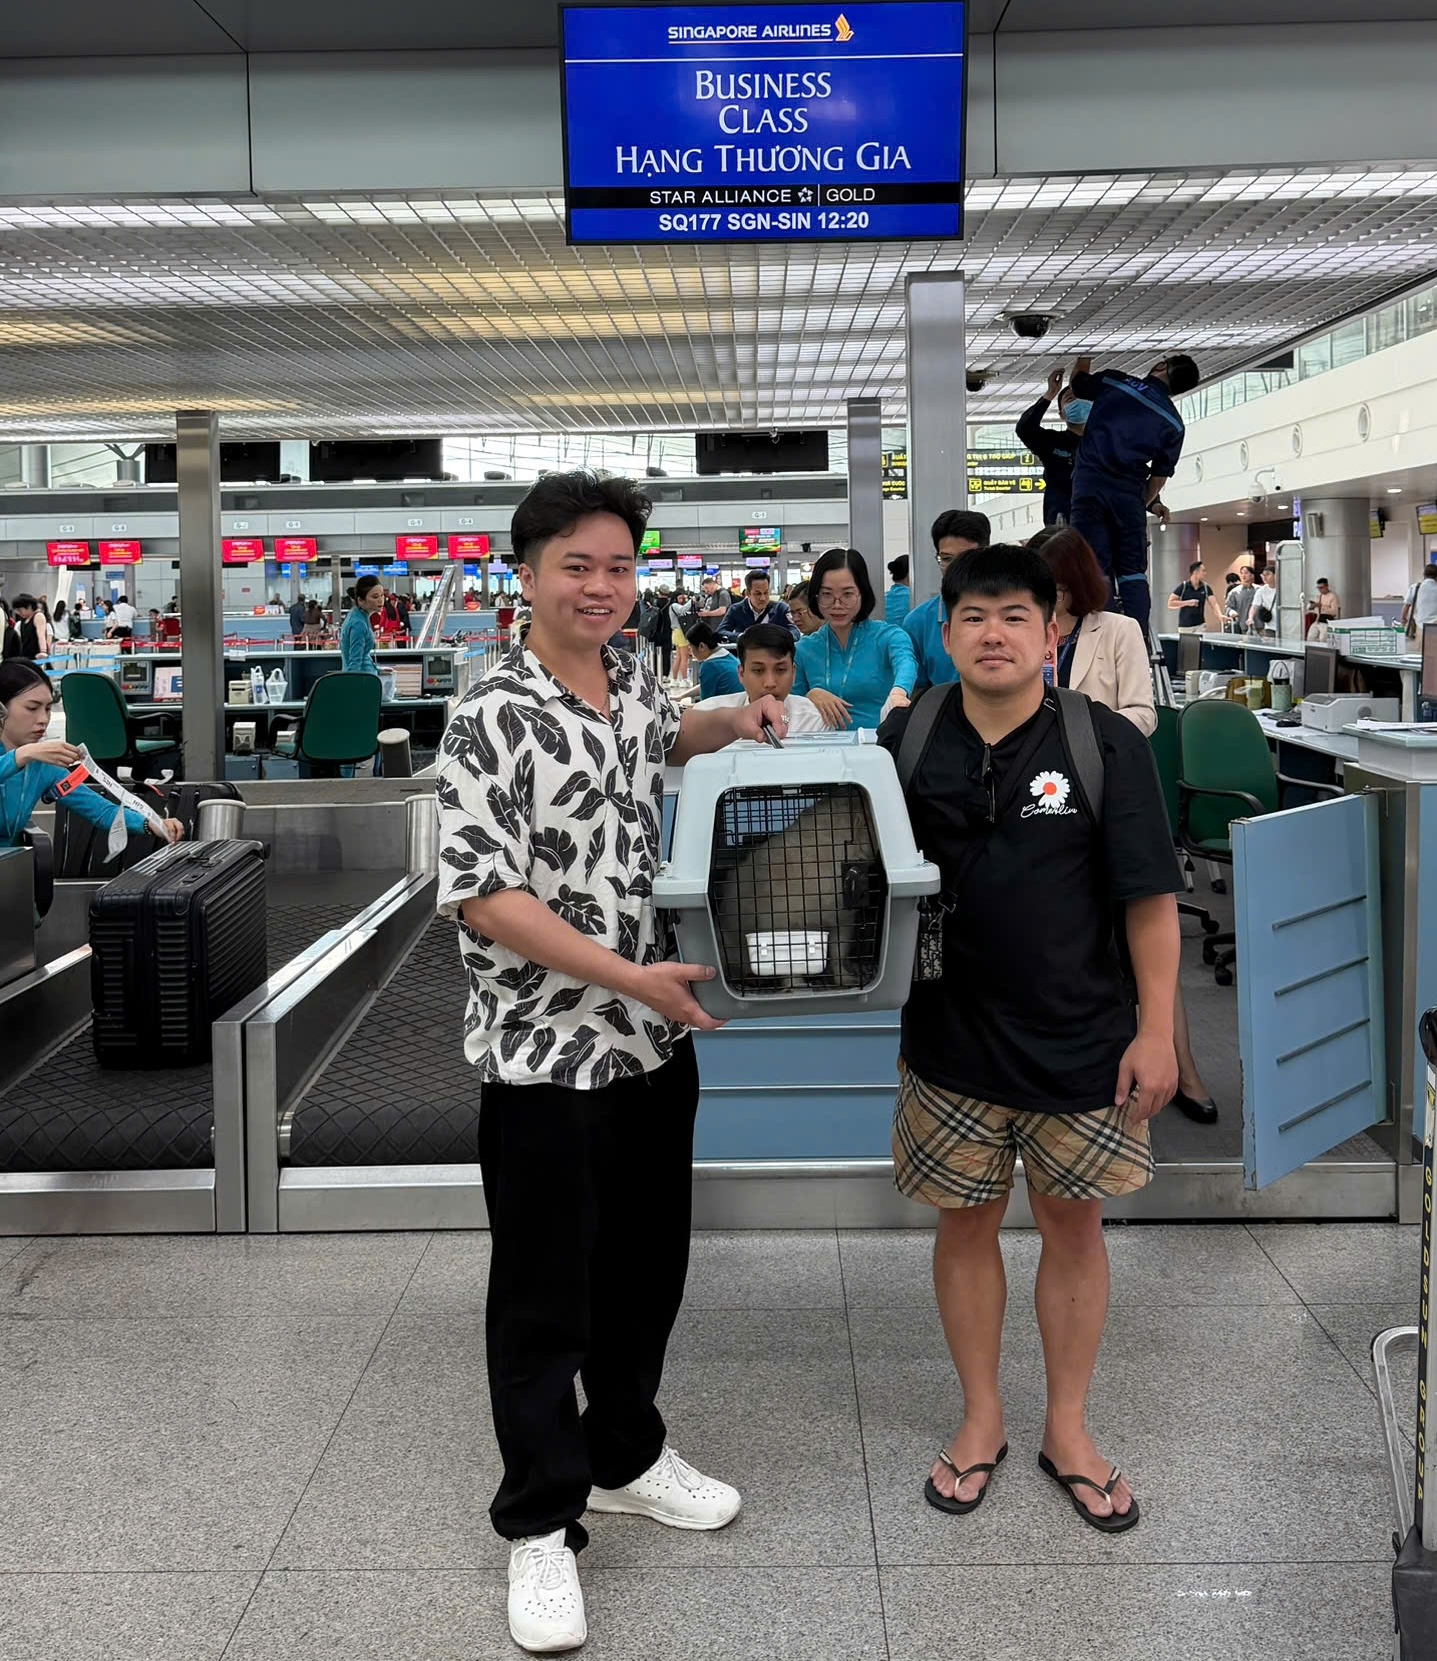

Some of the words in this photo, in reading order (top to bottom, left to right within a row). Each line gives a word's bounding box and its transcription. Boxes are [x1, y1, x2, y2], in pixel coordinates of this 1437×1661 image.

[668, 25, 758, 39] SINGAPORE
[761, 24, 832, 38] AIRLINES
[695, 70, 832, 101] BUSINESS
[718, 105, 809, 135] CLASS
[616, 146, 703, 178] HẠNG
[714, 144, 844, 173] THƯƠNG
[856, 141, 912, 171] GIA
[650, 190, 696, 205] STAR
[701, 189, 792, 204] ALLIANCE
[826, 187, 876, 202] GOLD
[659, 213, 722, 232] SQ177
[727, 212, 811, 231] SGN-SIN
[817, 211, 870, 230] 12:20
[1421, 1165, 1432, 1350] GOLDSUN
